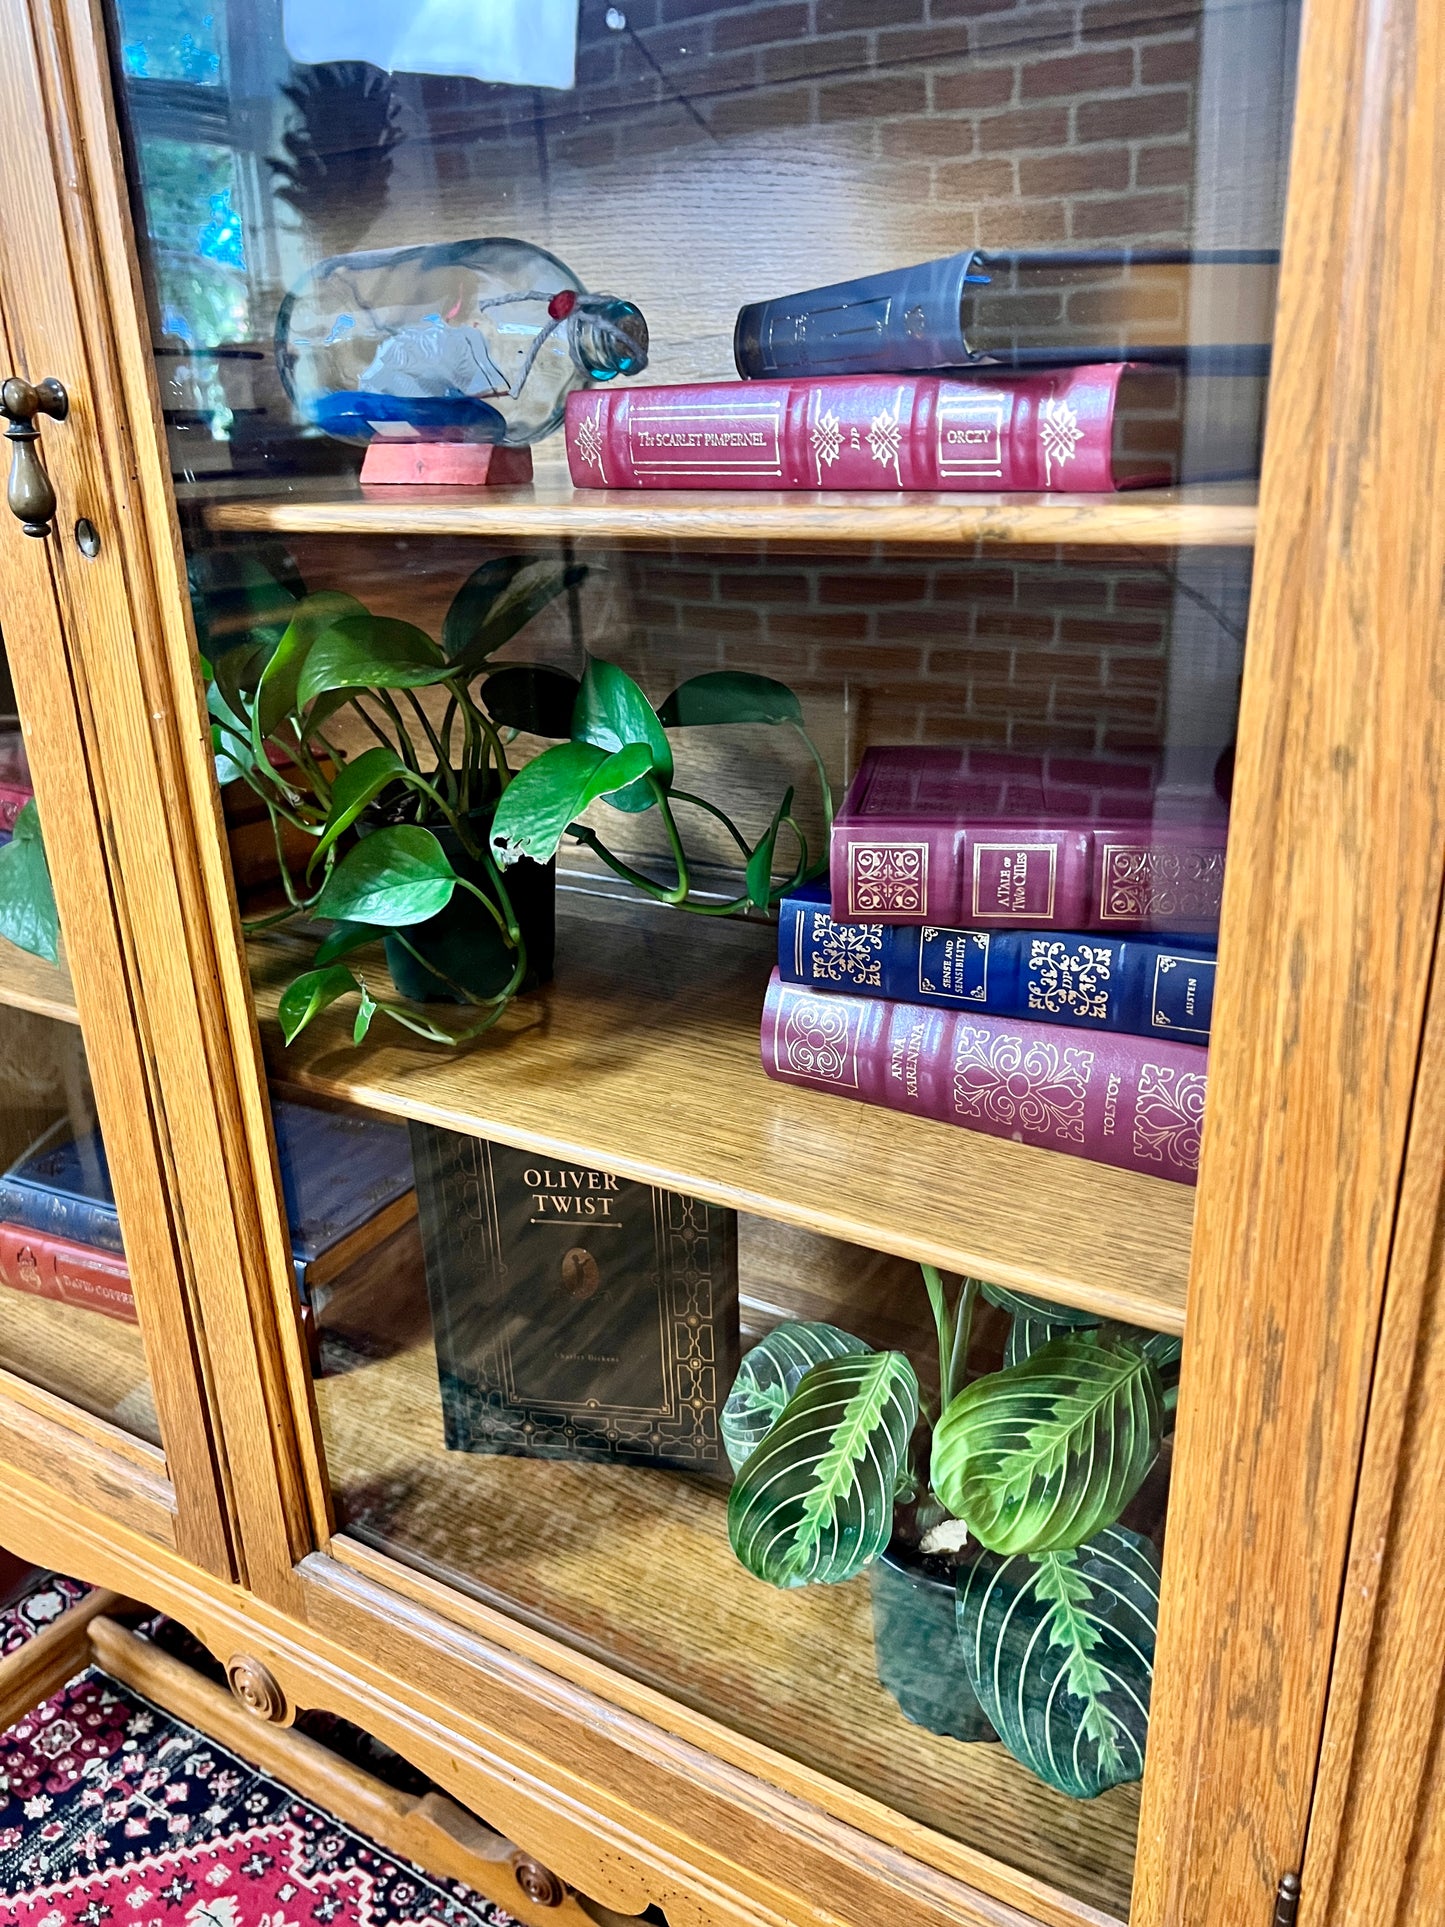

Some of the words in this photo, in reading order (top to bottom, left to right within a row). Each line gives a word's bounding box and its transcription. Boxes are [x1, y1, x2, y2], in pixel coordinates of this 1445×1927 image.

[655, 432, 703, 447] SCARLET
[704, 432, 767, 447] PIMPERNEL
[850, 427, 860, 451] DP
[946, 430, 991, 444] ORCZY
[997, 870, 1011, 897] TALE
[997, 898, 1010, 907] A
[945, 940, 954, 960] AND
[942, 960, 952, 989] SENSE
[954, 936, 966, 994] SENSIBILITY
[1062, 971, 1073, 989] DP
[1185, 978, 1197, 1016] AUSTEN
[891, 1036, 907, 1081] ANNA
[905, 1022, 926, 1098] KARENINA
[1103, 1072, 1121, 1136] TOLSTOY
[523, 1168, 620, 1191] OLIVER
[532, 1194, 614, 1216] TWIST
